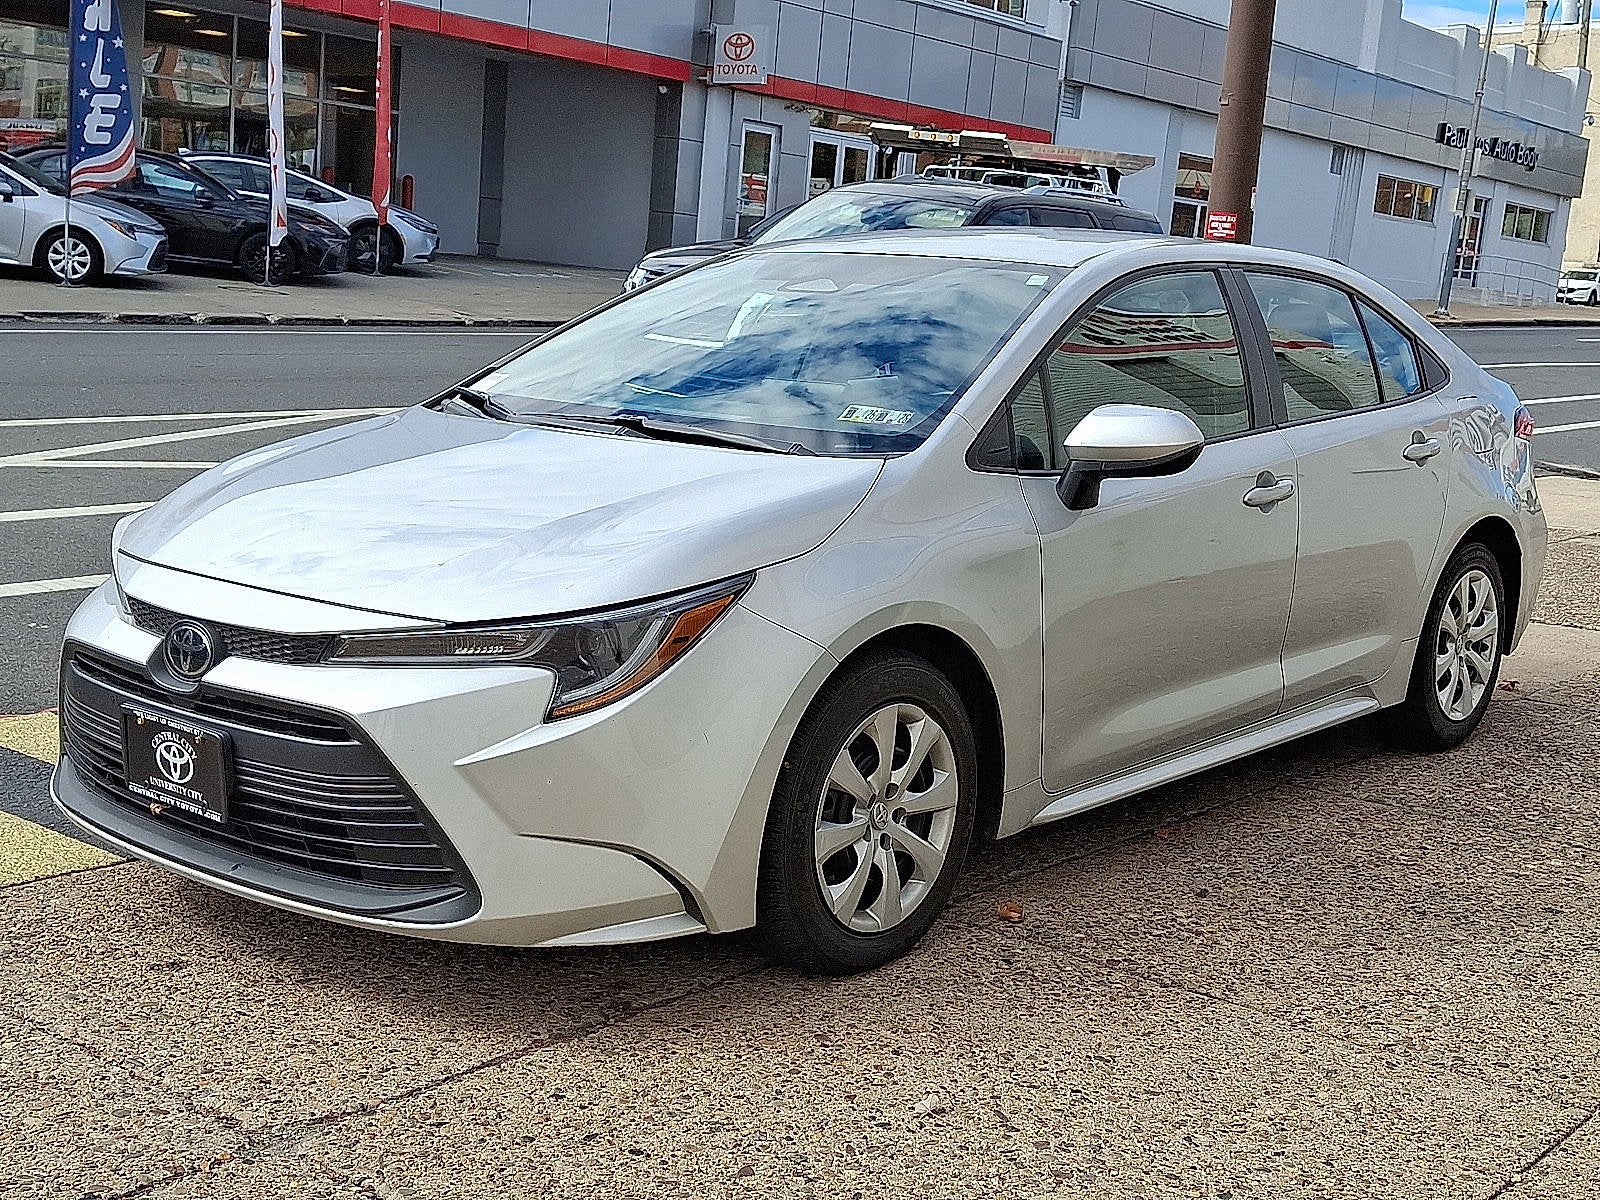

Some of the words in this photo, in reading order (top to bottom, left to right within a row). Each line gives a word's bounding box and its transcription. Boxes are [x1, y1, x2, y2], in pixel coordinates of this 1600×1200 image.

[717, 64, 758, 75] TOYOTA
[1440, 122, 1470, 149] Paul
[1494, 138, 1516, 162] Auto
[1517, 144, 1540, 171] Body
[151, 731, 181, 749] CENTRAL
[180, 738, 198, 760] CITY
[128, 784, 159, 801] CENTRAL
[159, 795, 175, 806] CITY
[149, 775, 187, 797] UNIVERSITY
[187, 787, 204, 802] CITY
